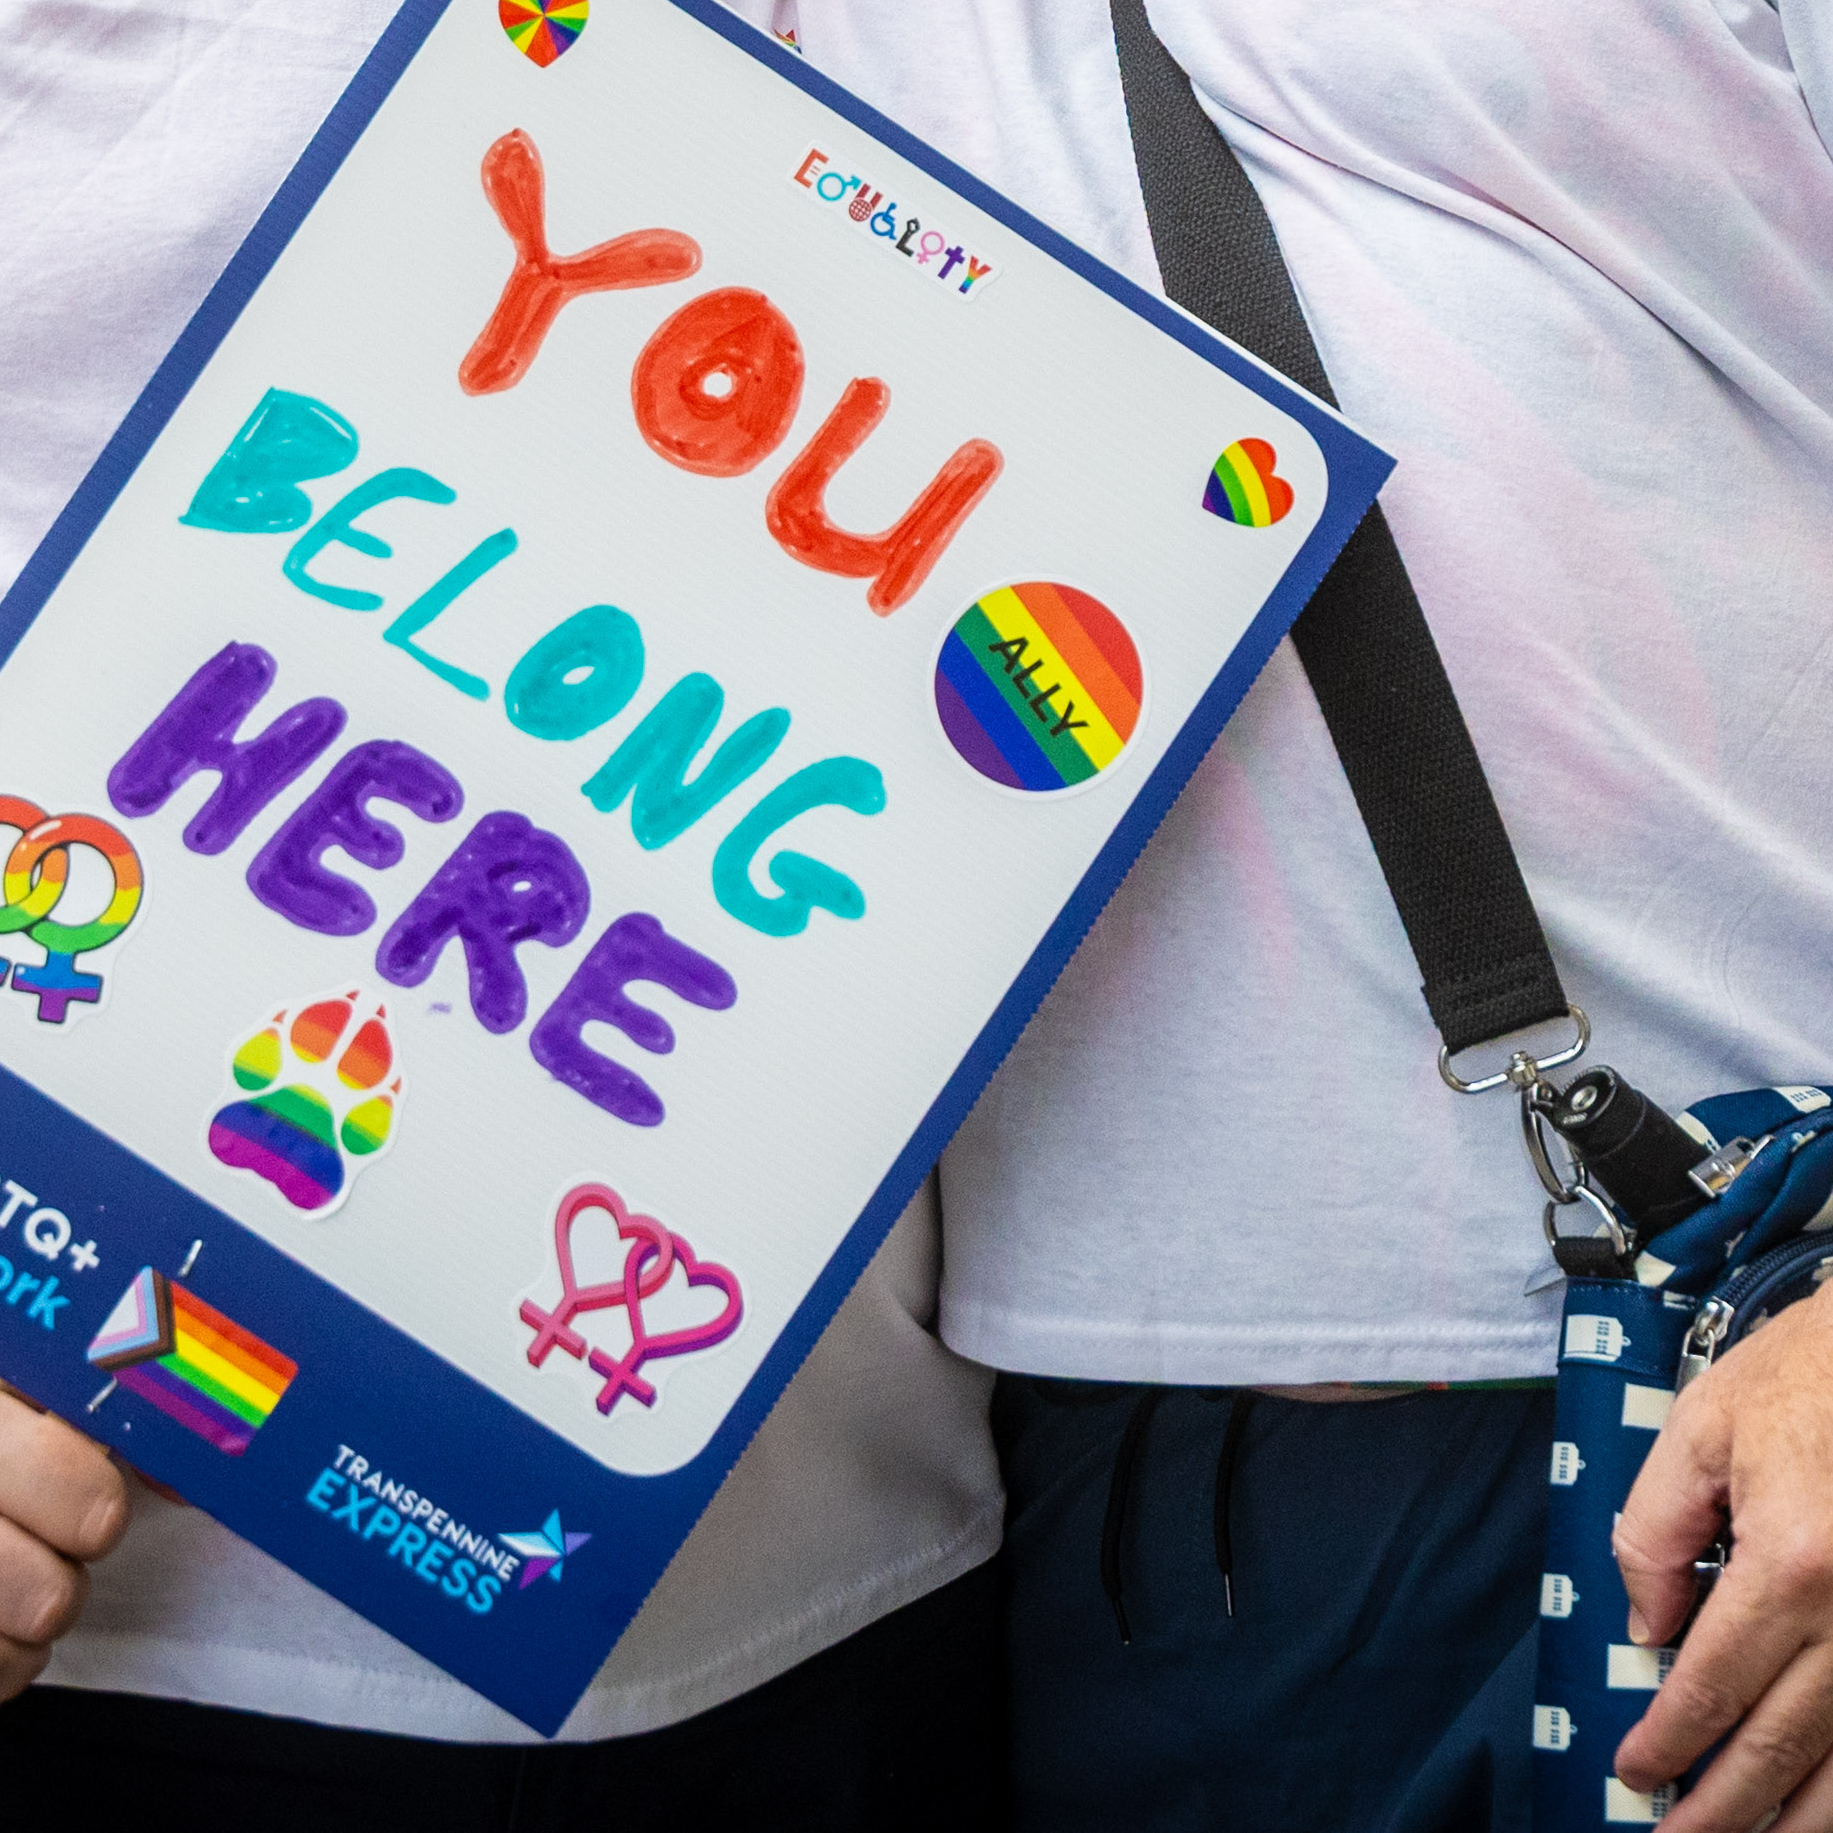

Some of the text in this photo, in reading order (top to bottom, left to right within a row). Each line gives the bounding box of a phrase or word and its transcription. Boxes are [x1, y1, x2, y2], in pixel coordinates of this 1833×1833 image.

[459, 127, 1005, 617] YOU
[178, 387, 888, 937] BELONG
[988, 637, 1089, 738] ALLY
[107, 640, 738, 1127] HERE
[306, 1467, 502, 1614] EXPRESS
[333, 1444, 521, 1581] TRANSPENNINE
